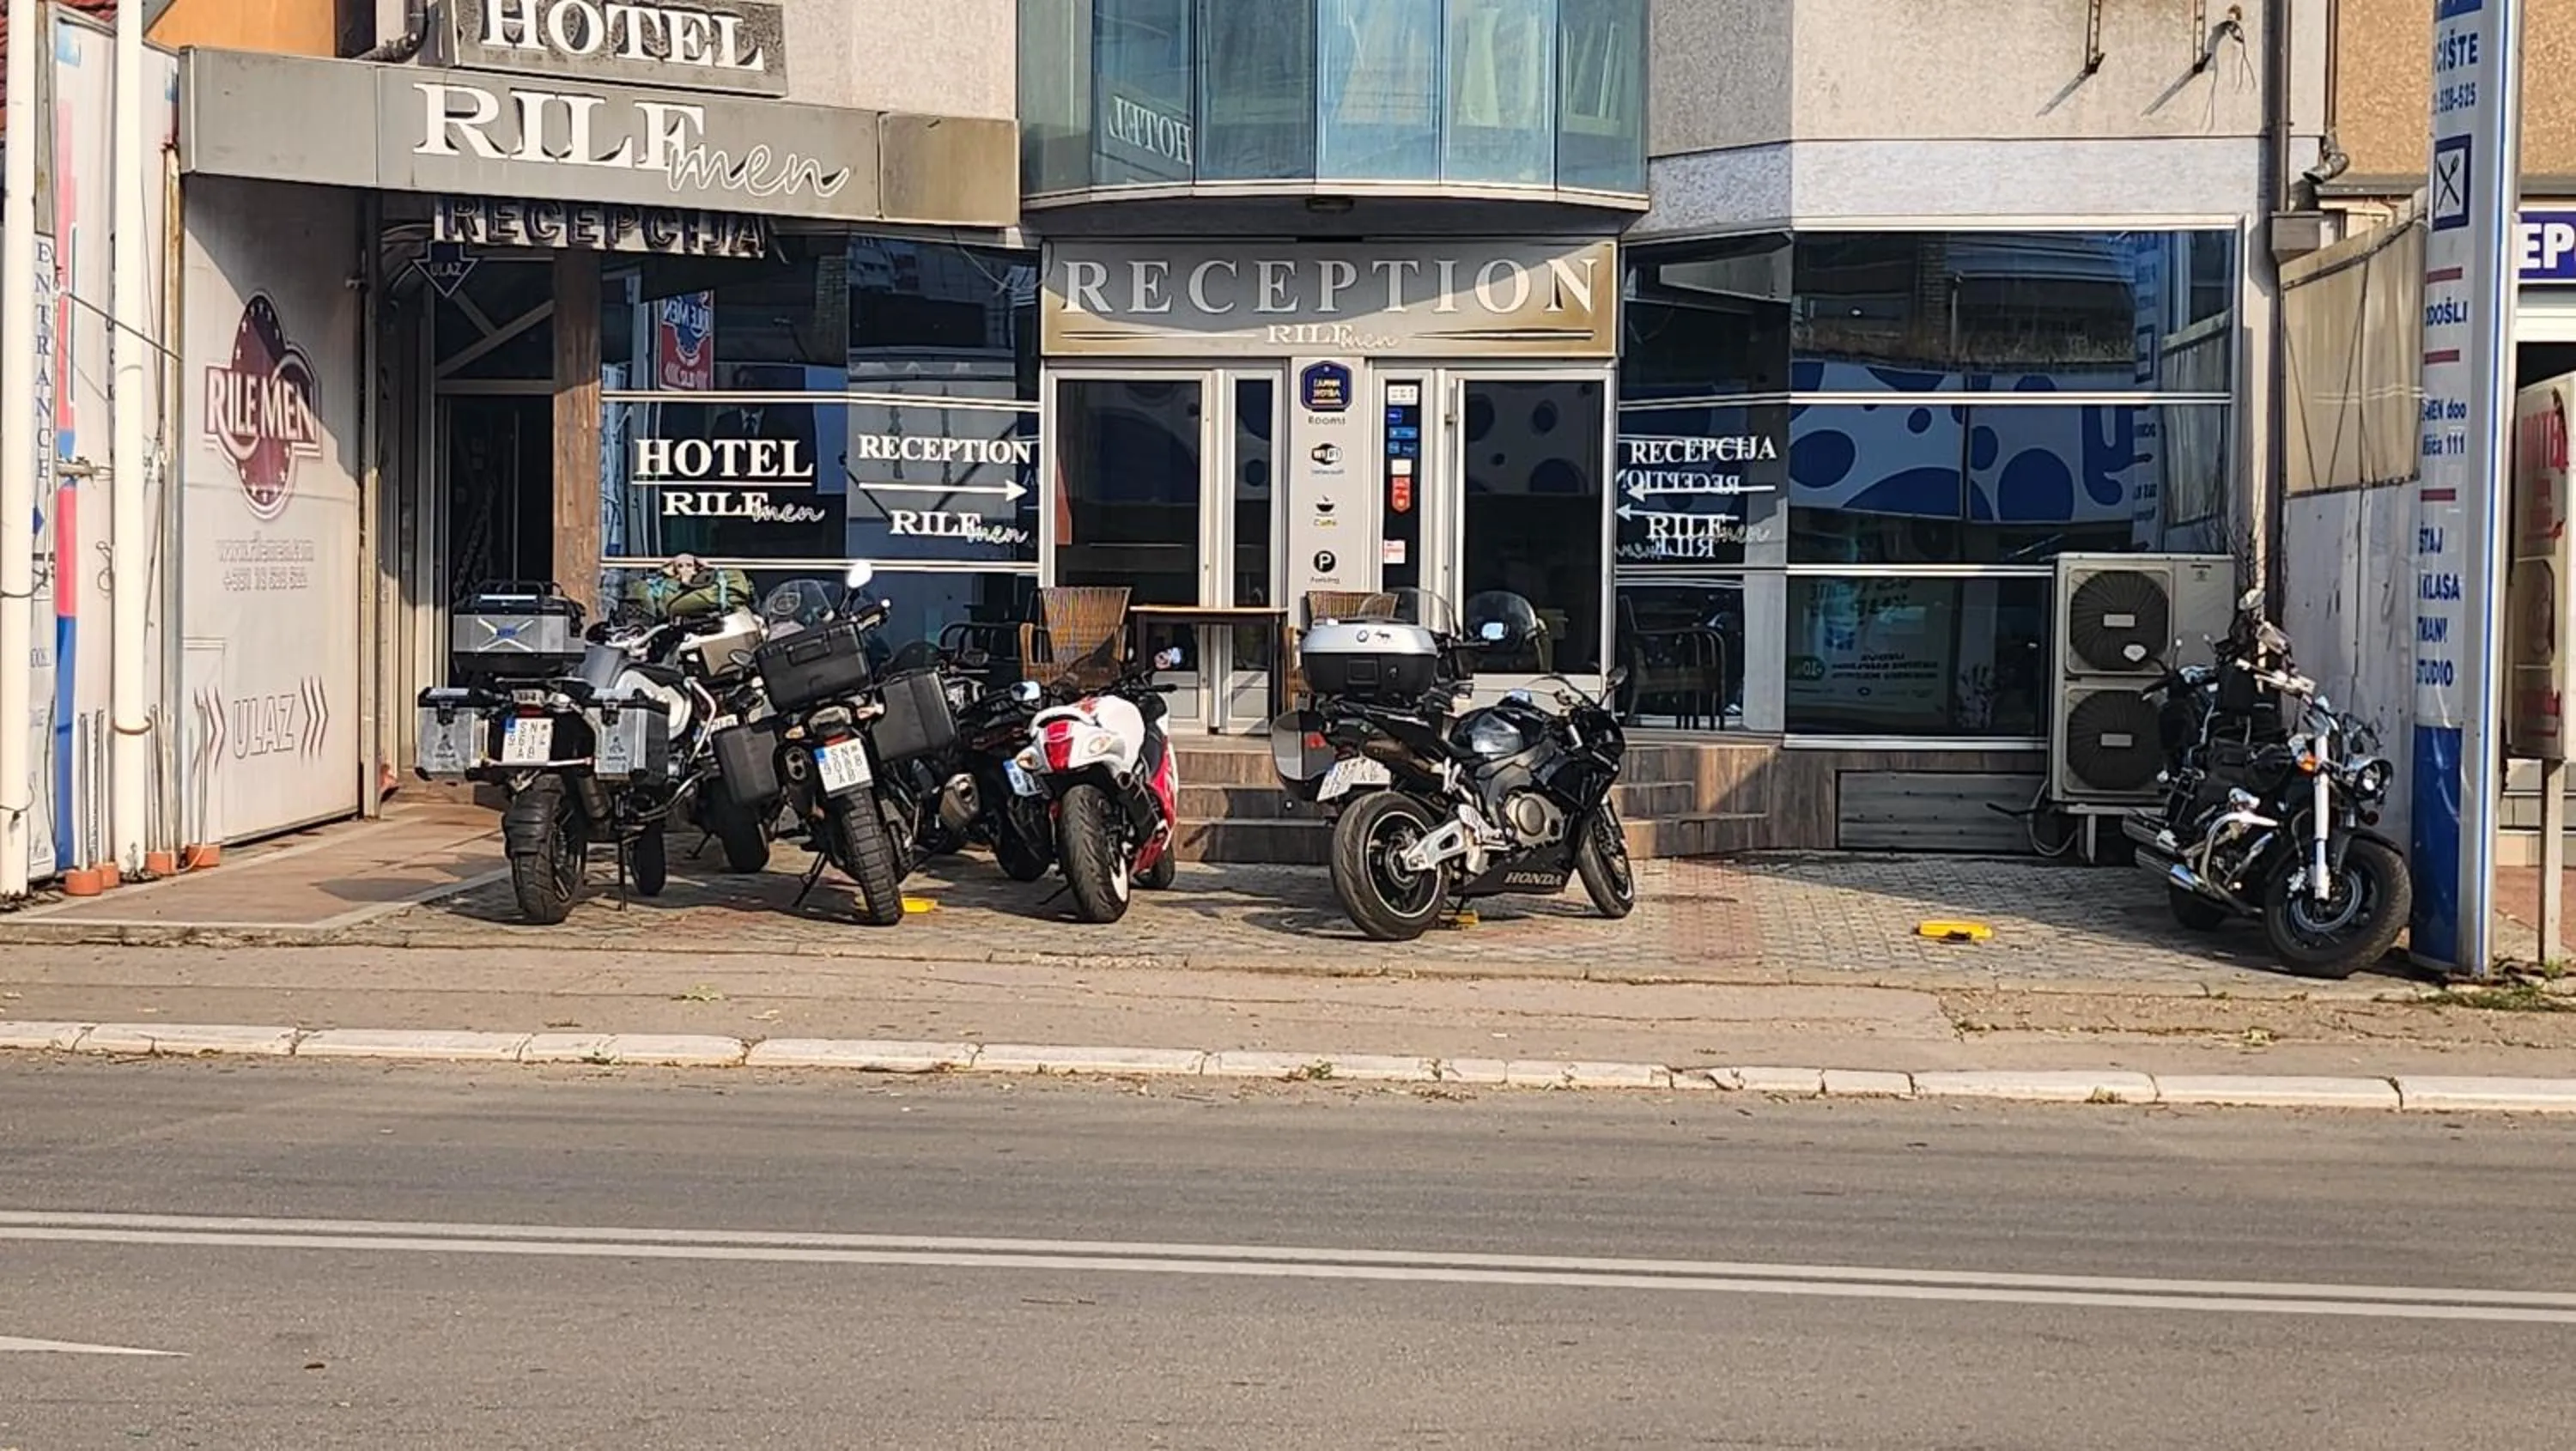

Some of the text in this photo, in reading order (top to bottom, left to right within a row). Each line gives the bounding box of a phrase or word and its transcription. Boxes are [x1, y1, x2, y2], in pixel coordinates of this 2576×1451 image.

[481, 0, 764, 70] HOTEL
[412, 82, 849, 198] RILE men
[443, 197, 769, 257] RECEPCIJA
[430, 262, 462, 276] ULAZ
[1060, 258, 1598, 315] RECEPTION
[1265, 324, 1400, 350] RILE men
[34, 242, 52, 477] ENTRANCE
[635, 438, 815, 478] HOTEL
[859, 434, 1031, 464] RECEPTION
[1629, 435, 1777, 464] RECEPCIJA
[2446, 432, 2464, 454] 111
[662, 493, 824, 523] RILE men
[889, 509, 1030, 544] RILE men
[1646, 513, 1728, 539] RILE
[233, 694, 296, 760] ULAZ
[1504, 871, 1563, 885] HONDA
